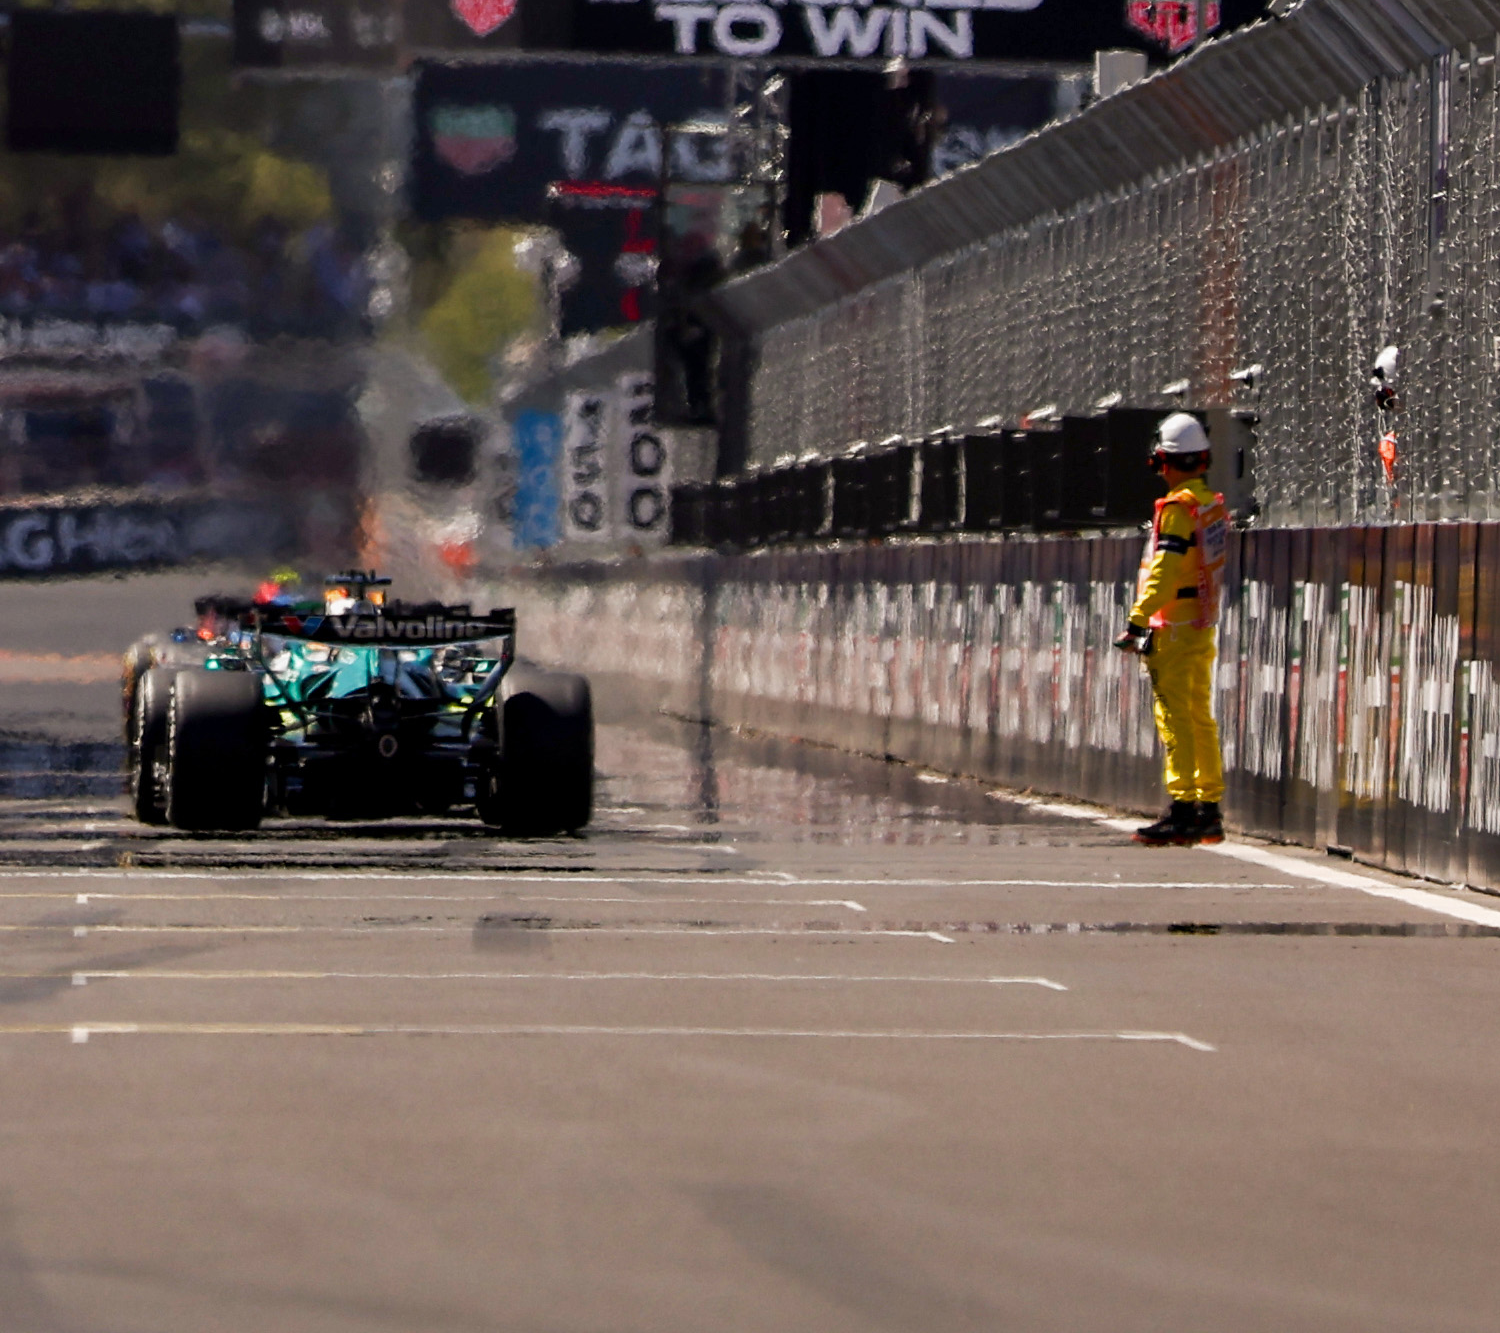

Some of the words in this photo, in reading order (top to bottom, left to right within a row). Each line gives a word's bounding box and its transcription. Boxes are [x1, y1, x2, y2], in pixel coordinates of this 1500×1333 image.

[656, 4, 783, 57] TO
[804, 8, 975, 59] WIN
[335, 615, 487, 642] Valvoline
